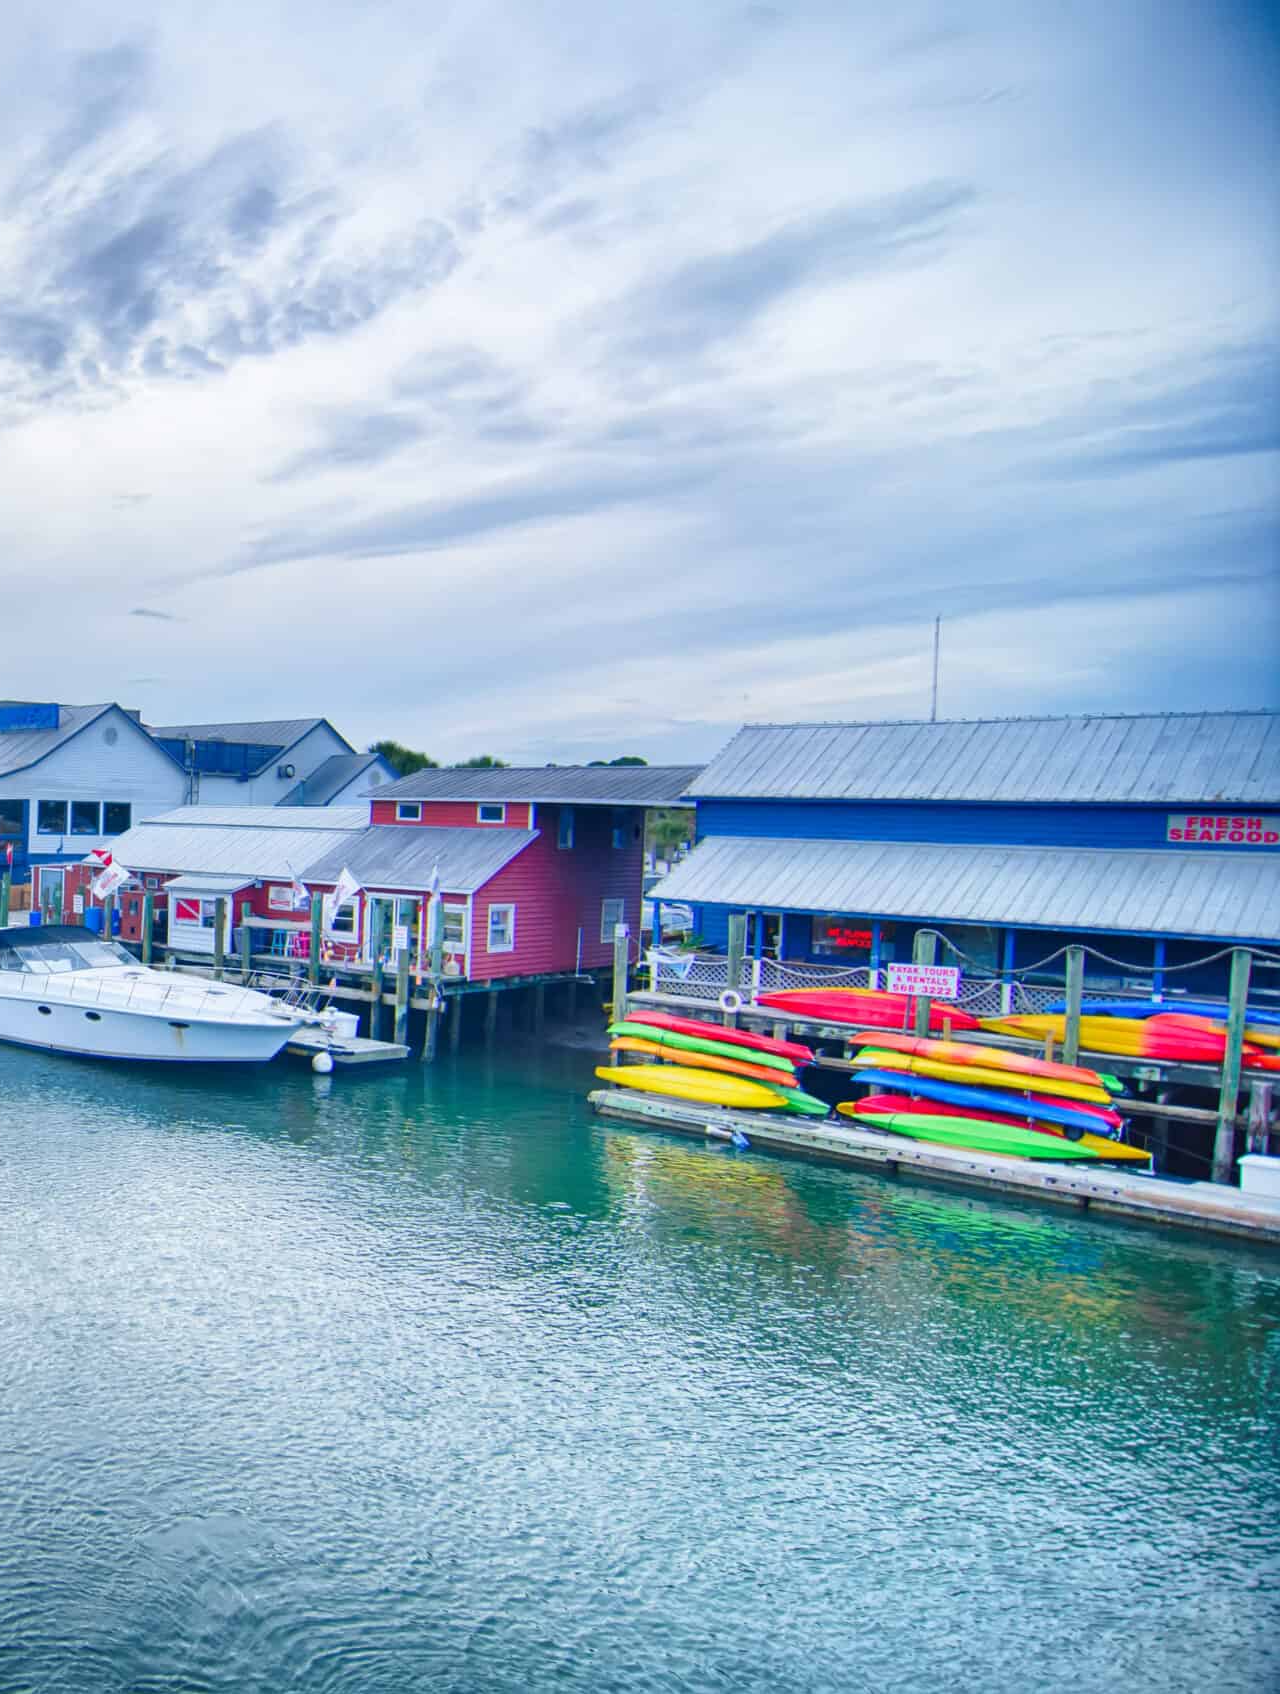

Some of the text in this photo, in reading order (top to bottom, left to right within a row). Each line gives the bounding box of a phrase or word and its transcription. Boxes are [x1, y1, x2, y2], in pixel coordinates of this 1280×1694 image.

[1185, 816, 1262, 829] FRESH
[1169, 828, 1279, 843] SEAFOOD
[889, 965, 955, 976] KAYAK TOURS
[906, 975, 948, 985] RENTALS
